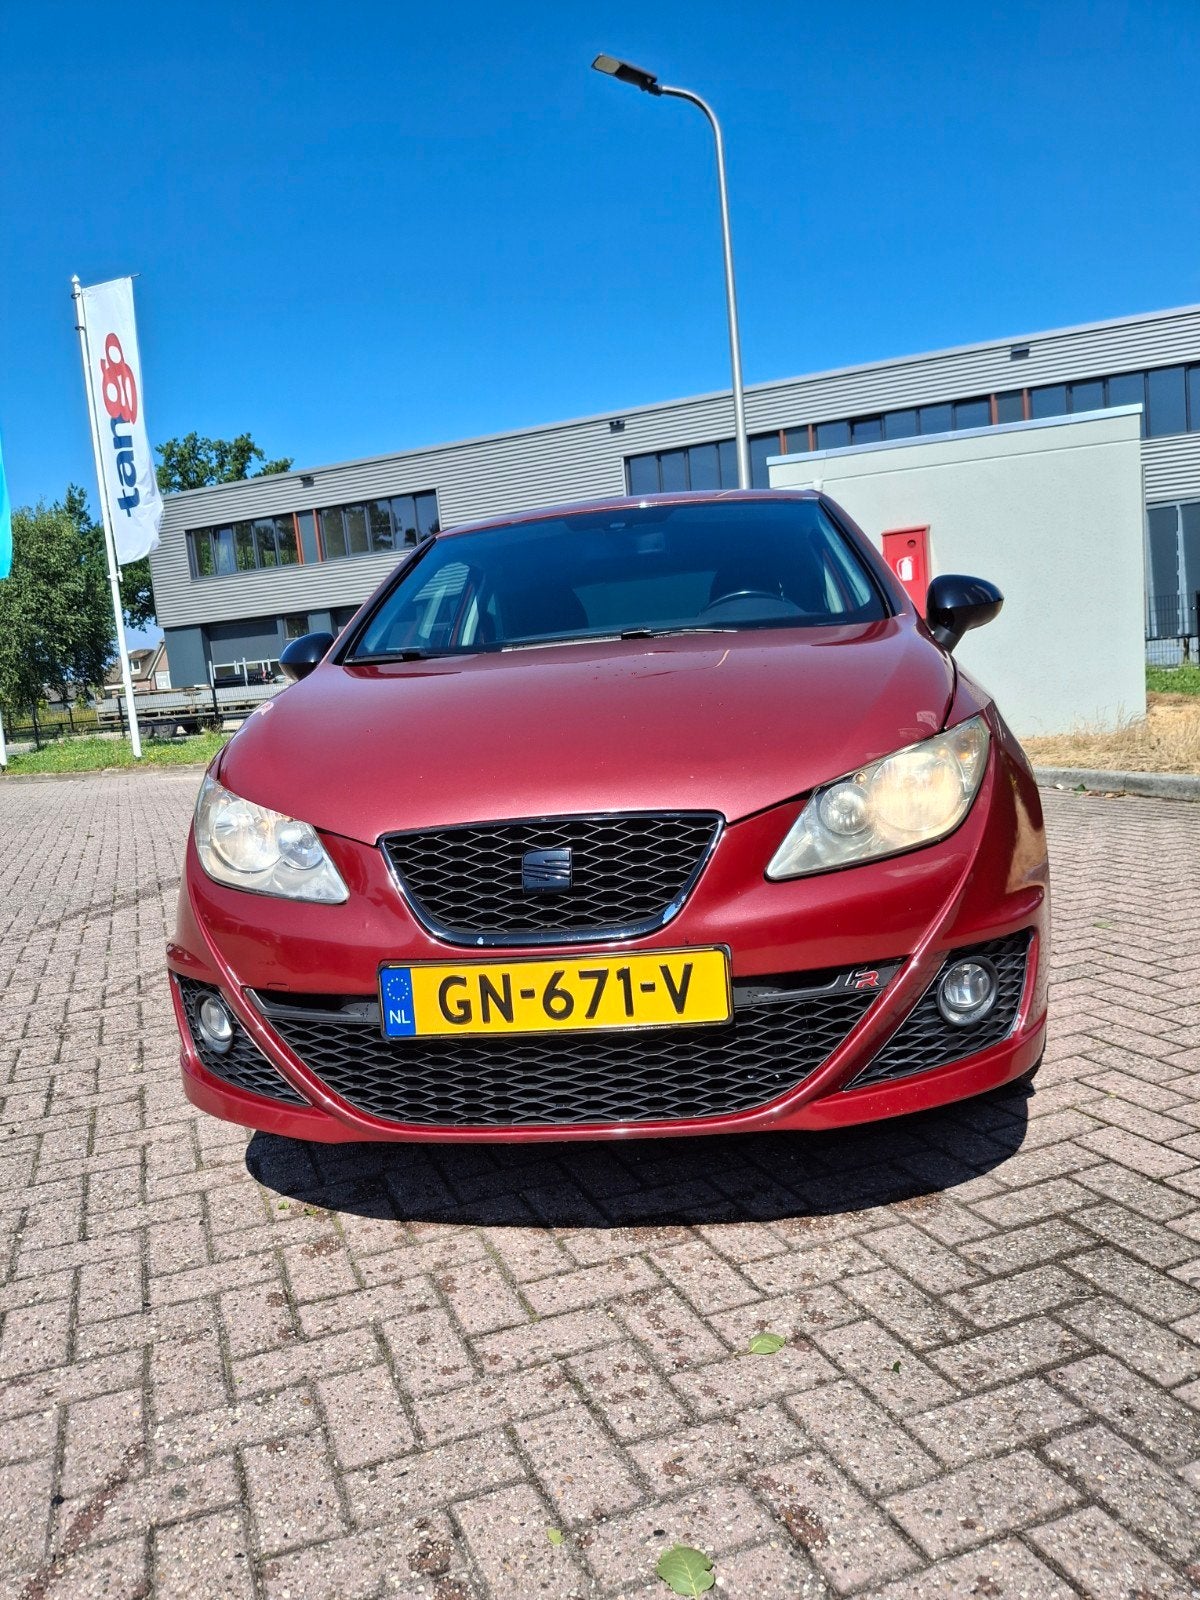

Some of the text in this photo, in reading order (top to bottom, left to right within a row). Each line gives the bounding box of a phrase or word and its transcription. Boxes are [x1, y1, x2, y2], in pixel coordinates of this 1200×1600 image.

[100, 332, 140, 517] tango
[389, 1009, 411, 1024] NL
[438, 962, 692, 1025] GN-671-V
